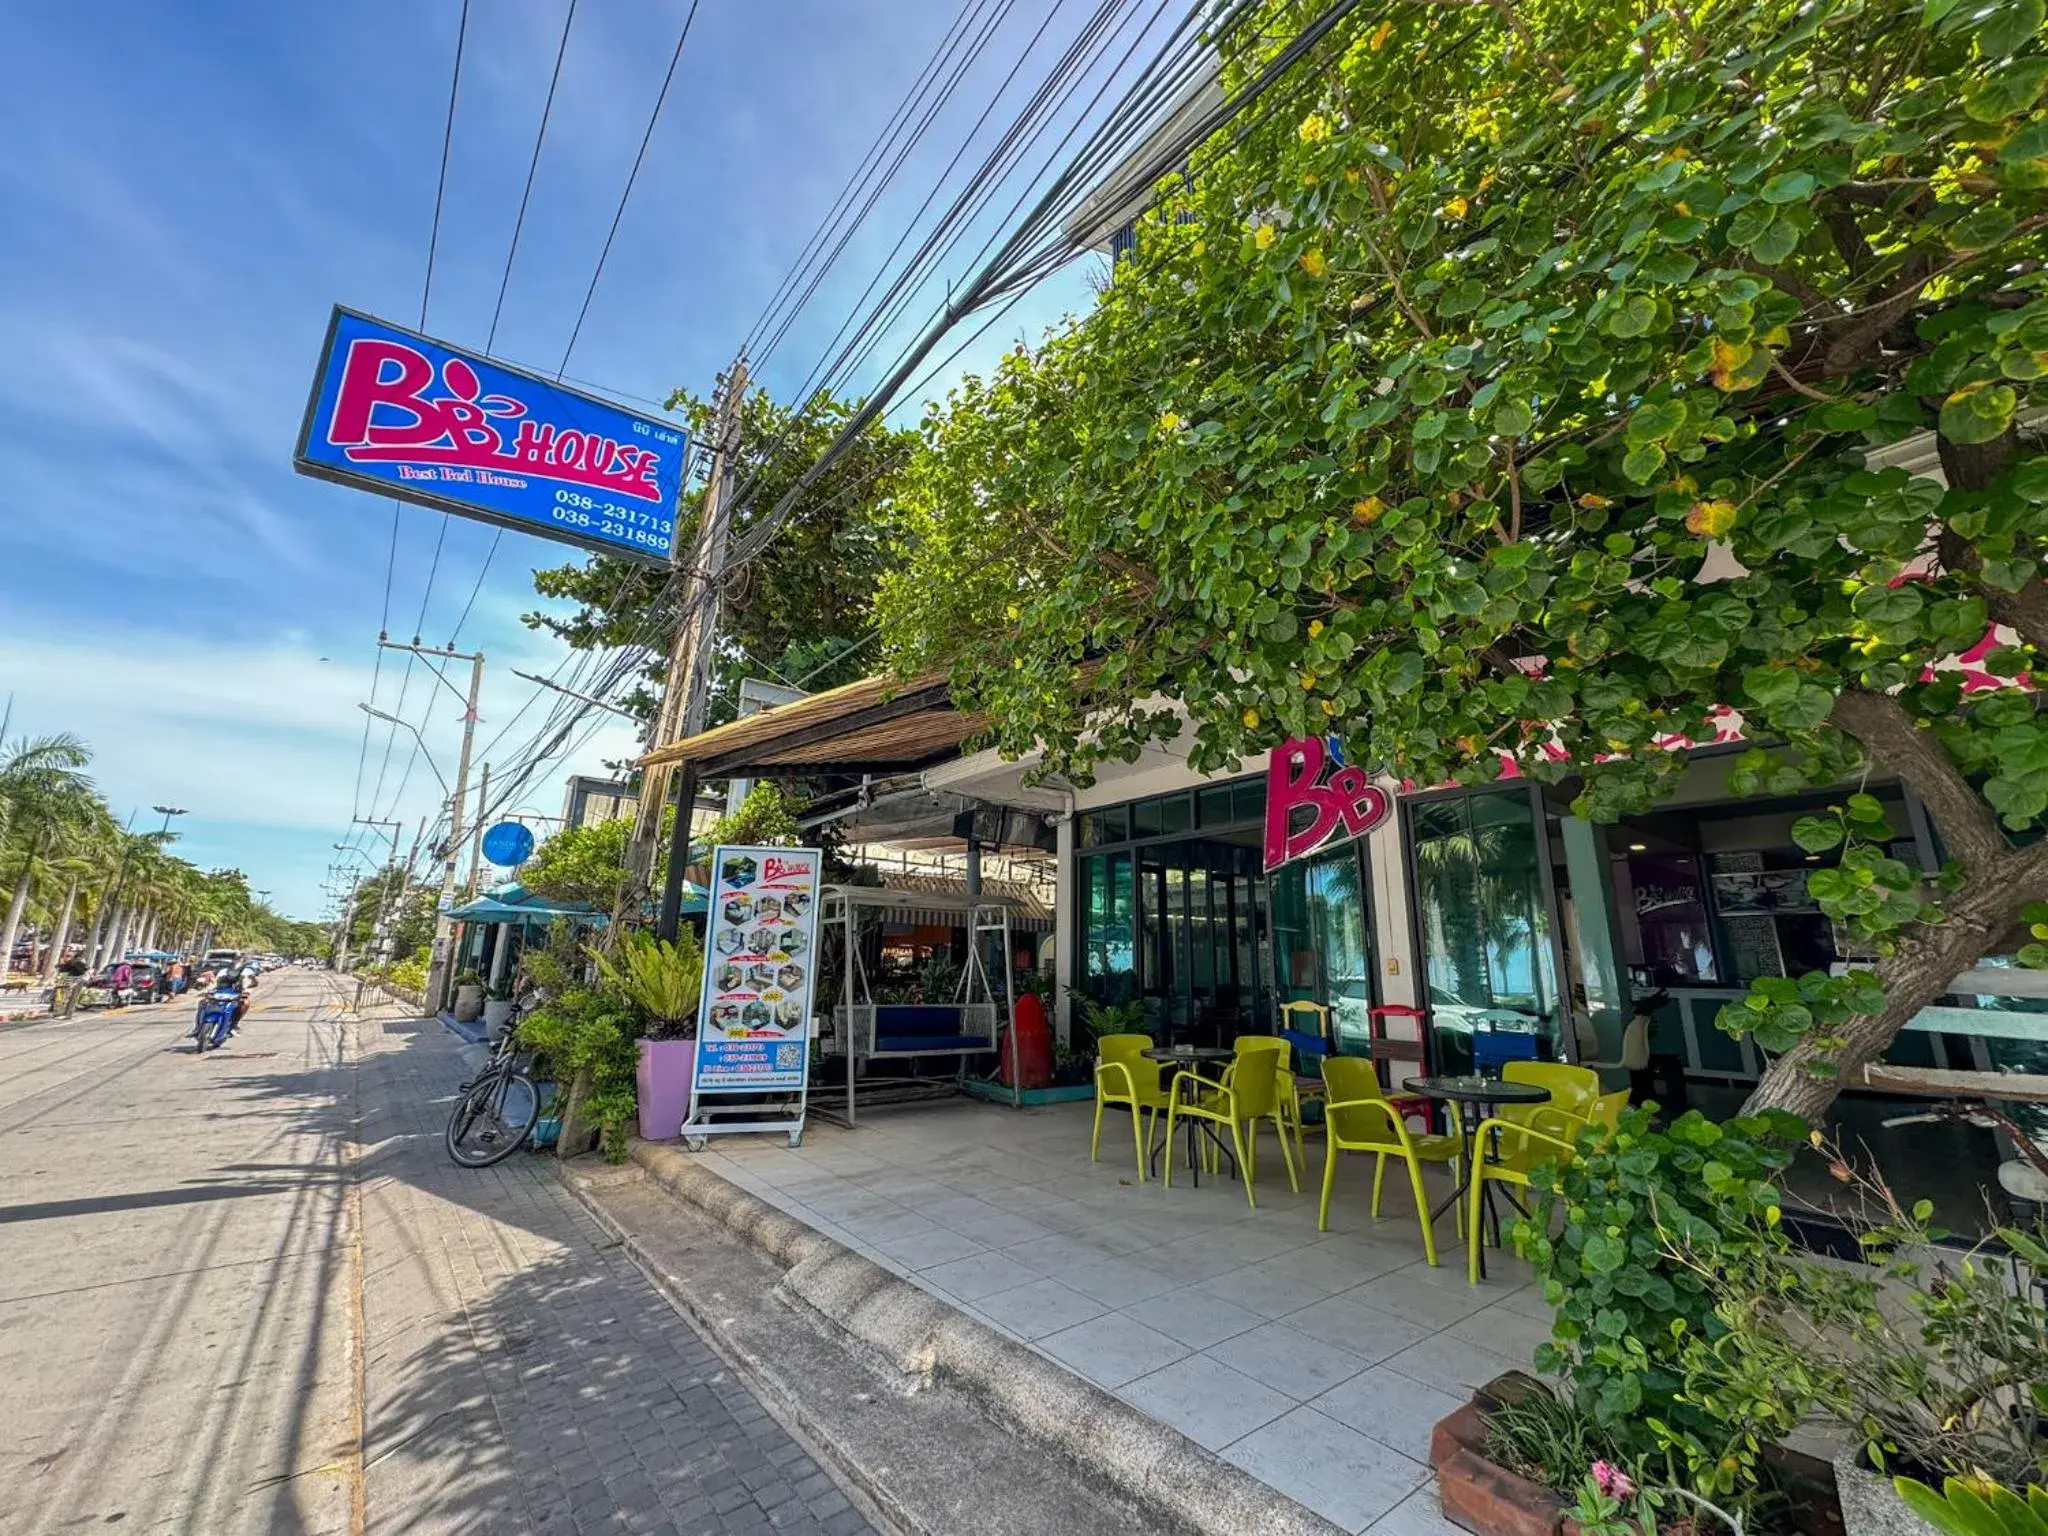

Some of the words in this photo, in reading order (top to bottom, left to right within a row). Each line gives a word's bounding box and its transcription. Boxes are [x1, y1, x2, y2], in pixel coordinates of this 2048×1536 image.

[328, 339, 502, 455] BB
[513, 421, 661, 487] HOUSE
[398, 465, 437, 480] Best
[439, 467, 473, 482] Bed
[475, 470, 527, 489] House
[552, 506, 669, 550] 038-231889
[555, 489, 671, 534] 038-231713
[1263, 735, 1388, 874] BB
